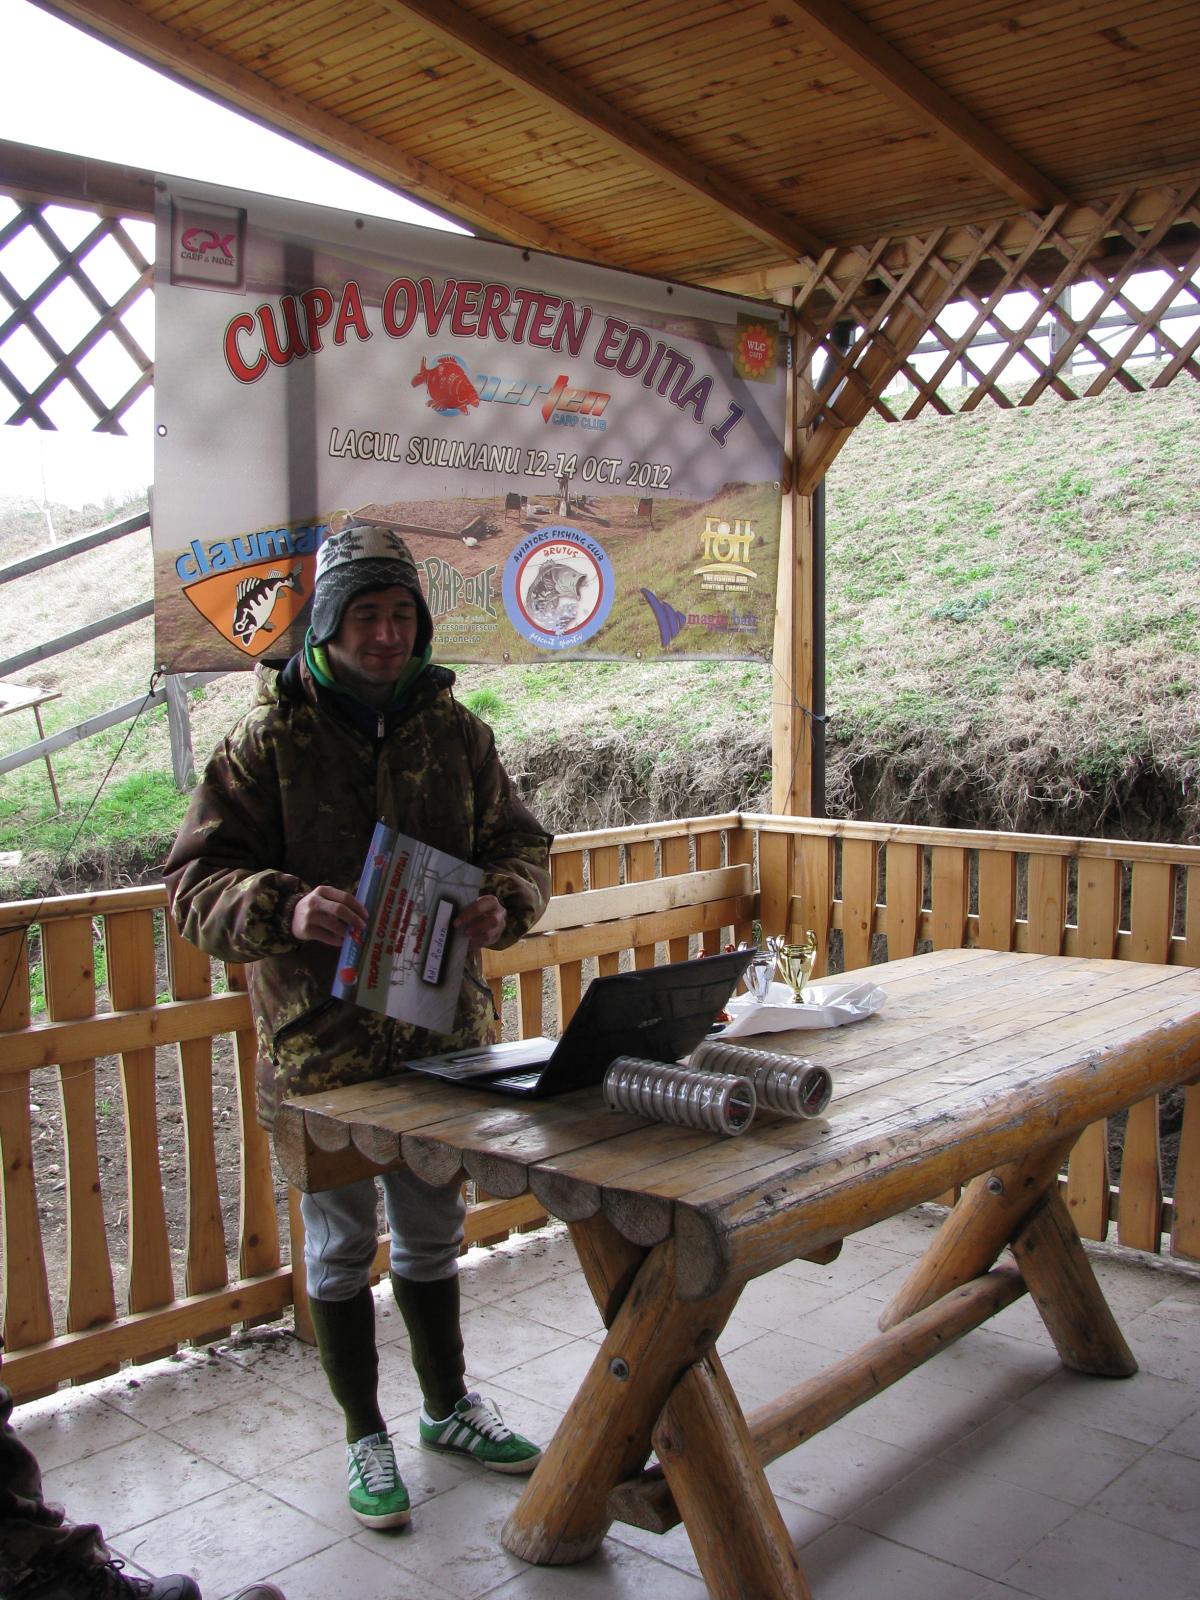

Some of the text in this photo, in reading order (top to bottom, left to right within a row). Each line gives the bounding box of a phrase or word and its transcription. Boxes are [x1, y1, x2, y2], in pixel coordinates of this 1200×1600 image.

[180, 251, 204, 262] CARP
[747, 340, 766, 352] WLC
[749, 351, 763, 360] carp
[223, 276, 745, 448] CUPA OVERTEN EDITIA 1
[552, 413, 607, 431] CARP CLUB
[328, 427, 673, 490] LACUL SULIMANU 12-14 OCT. 2012
[175, 524, 327, 582] claumar
[514, 529, 604, 563] AVIATORS FISHING CLUB
